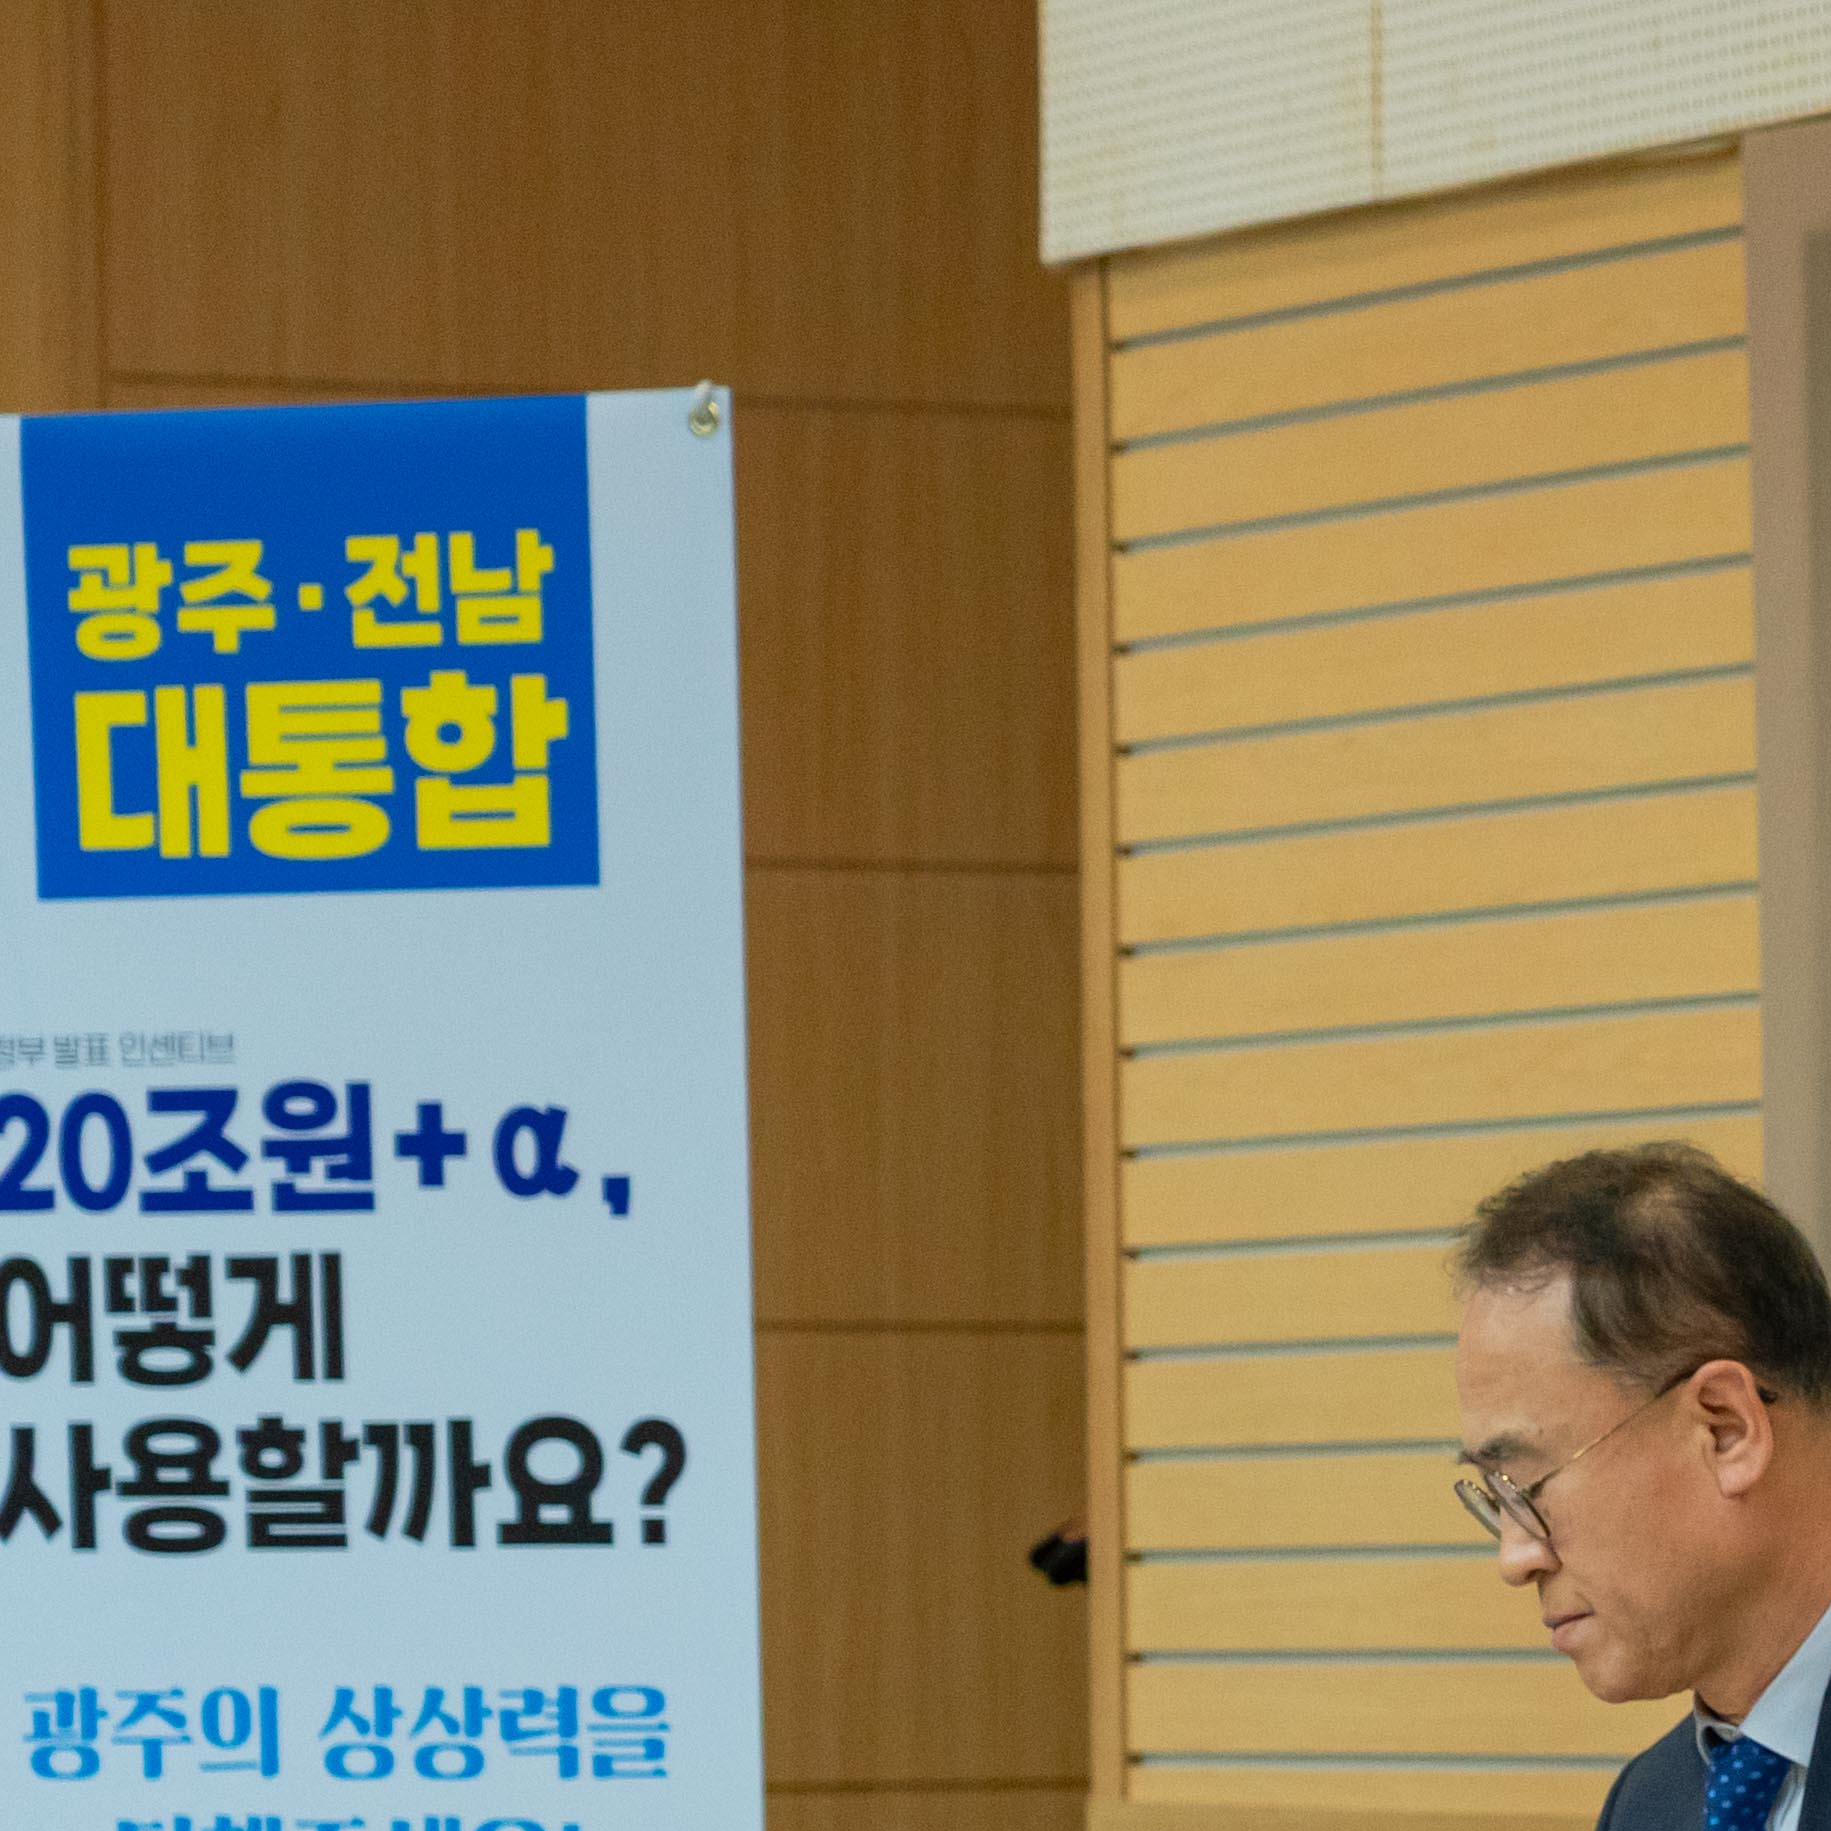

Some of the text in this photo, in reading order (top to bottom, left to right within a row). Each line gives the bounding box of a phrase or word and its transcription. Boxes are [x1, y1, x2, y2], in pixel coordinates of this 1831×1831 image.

[67, 529, 555, 661] 광주·전남
[73, 669, 569, 861] 대통합
[0, 1252, 345, 1387] 어떻게
[0, 1415, 688, 1554] 사용할까요?
[23, 1684, 671, 1782] 광주의 상상력을
